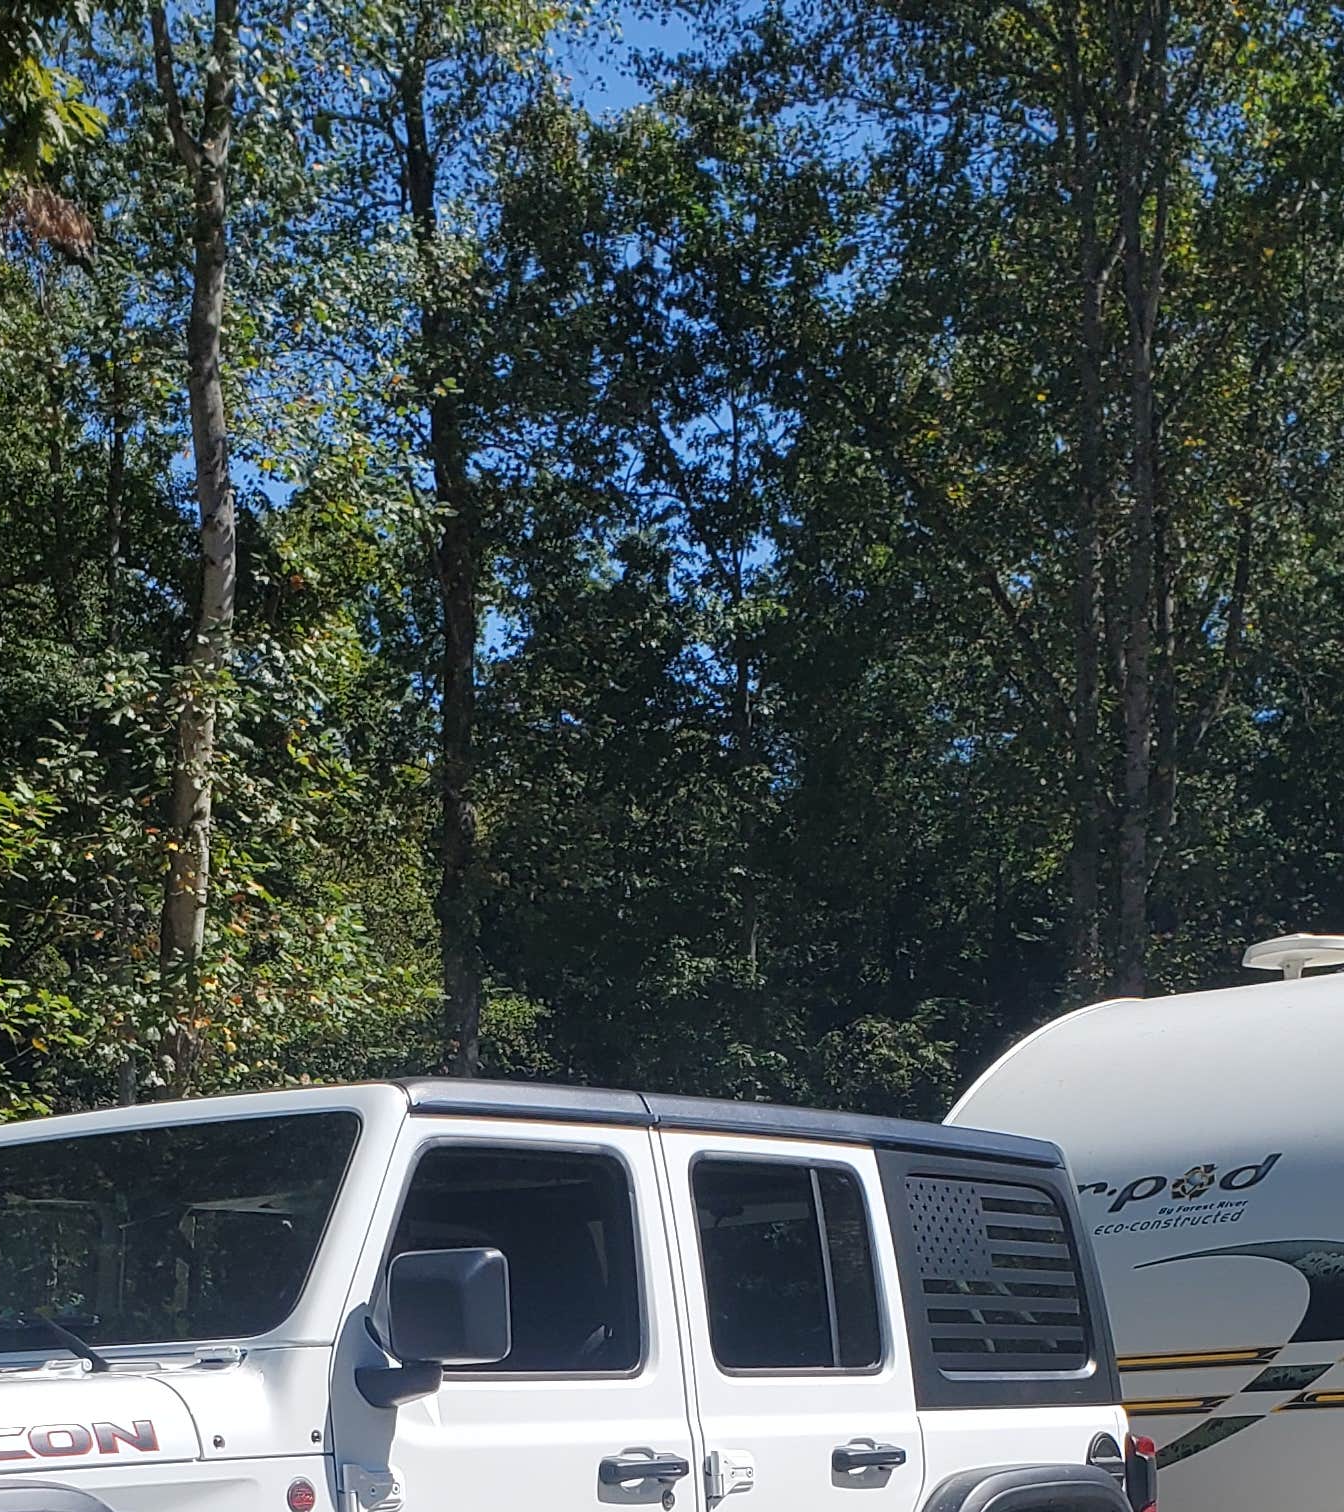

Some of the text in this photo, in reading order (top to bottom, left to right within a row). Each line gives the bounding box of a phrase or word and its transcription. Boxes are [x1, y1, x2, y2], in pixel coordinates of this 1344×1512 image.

[1158, 1199, 1249, 1216] By Forest River
[1094, 1208, 1245, 1236] eco-constructed
